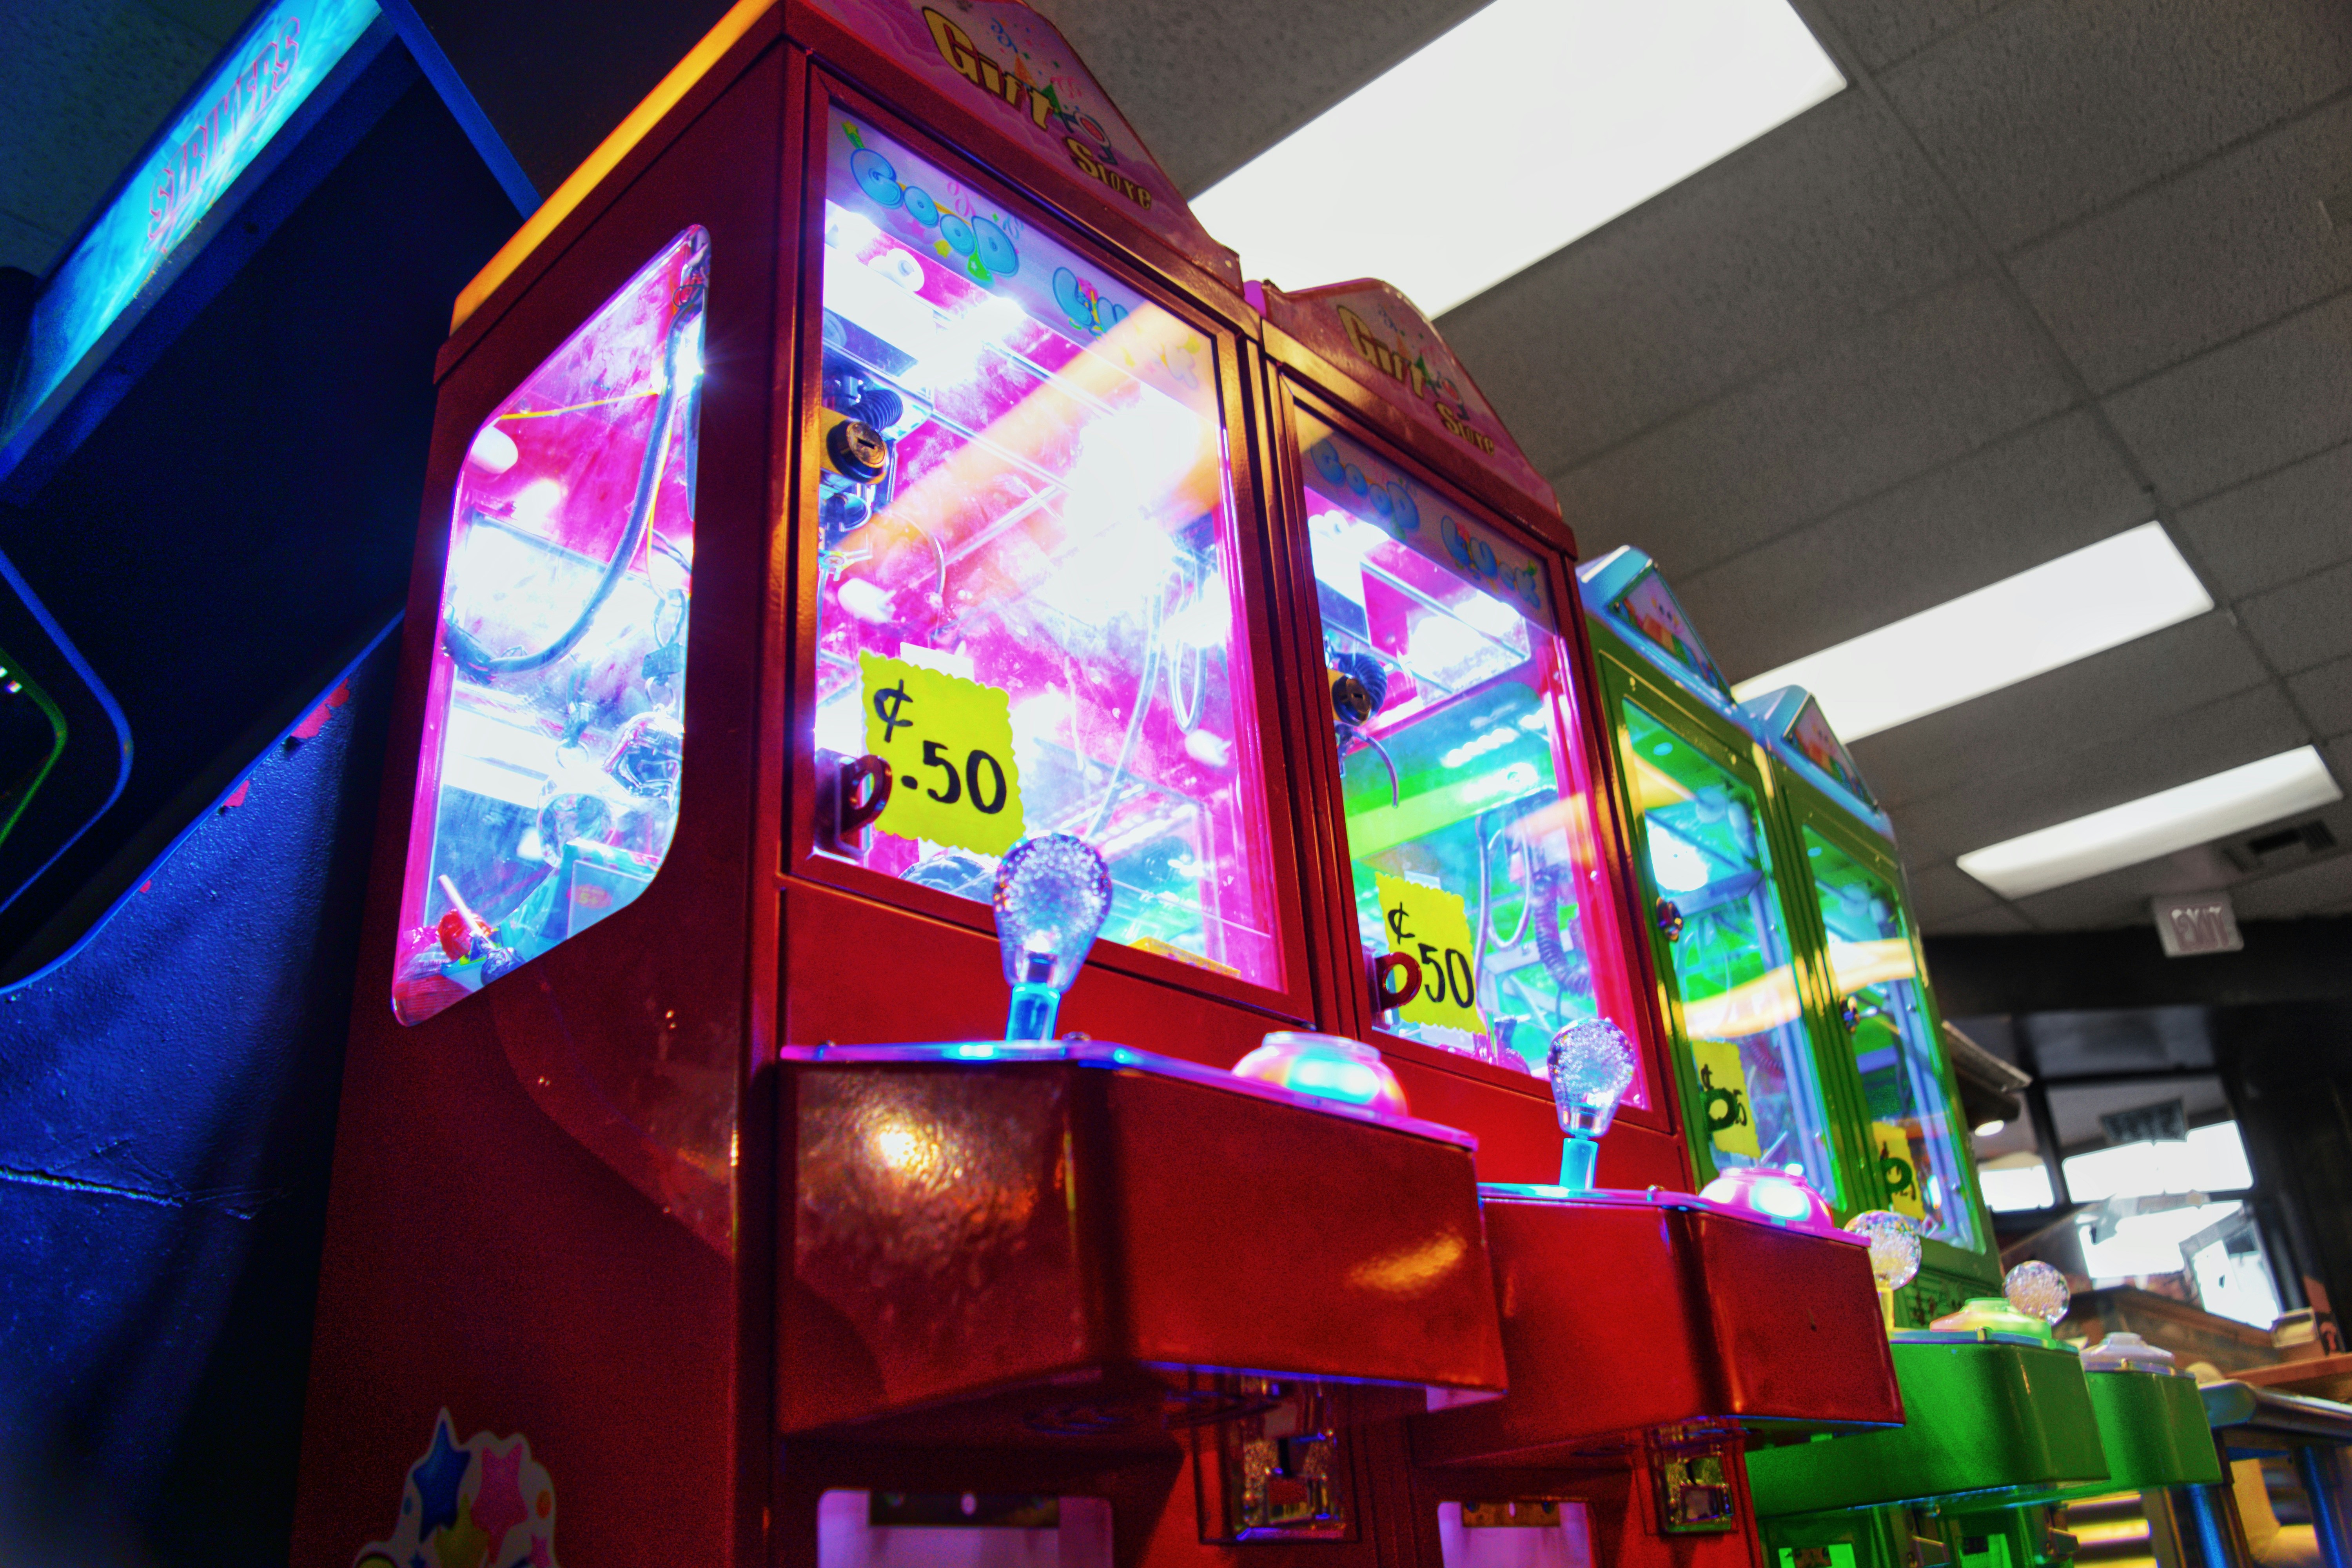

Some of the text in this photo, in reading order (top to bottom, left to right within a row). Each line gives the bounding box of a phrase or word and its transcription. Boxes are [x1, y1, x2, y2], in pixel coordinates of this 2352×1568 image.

[148, 16, 300, 240] STRIKERS
[922, 7, 1152, 210] Gift Store
[1337, 305, 1428, 400] Gift
